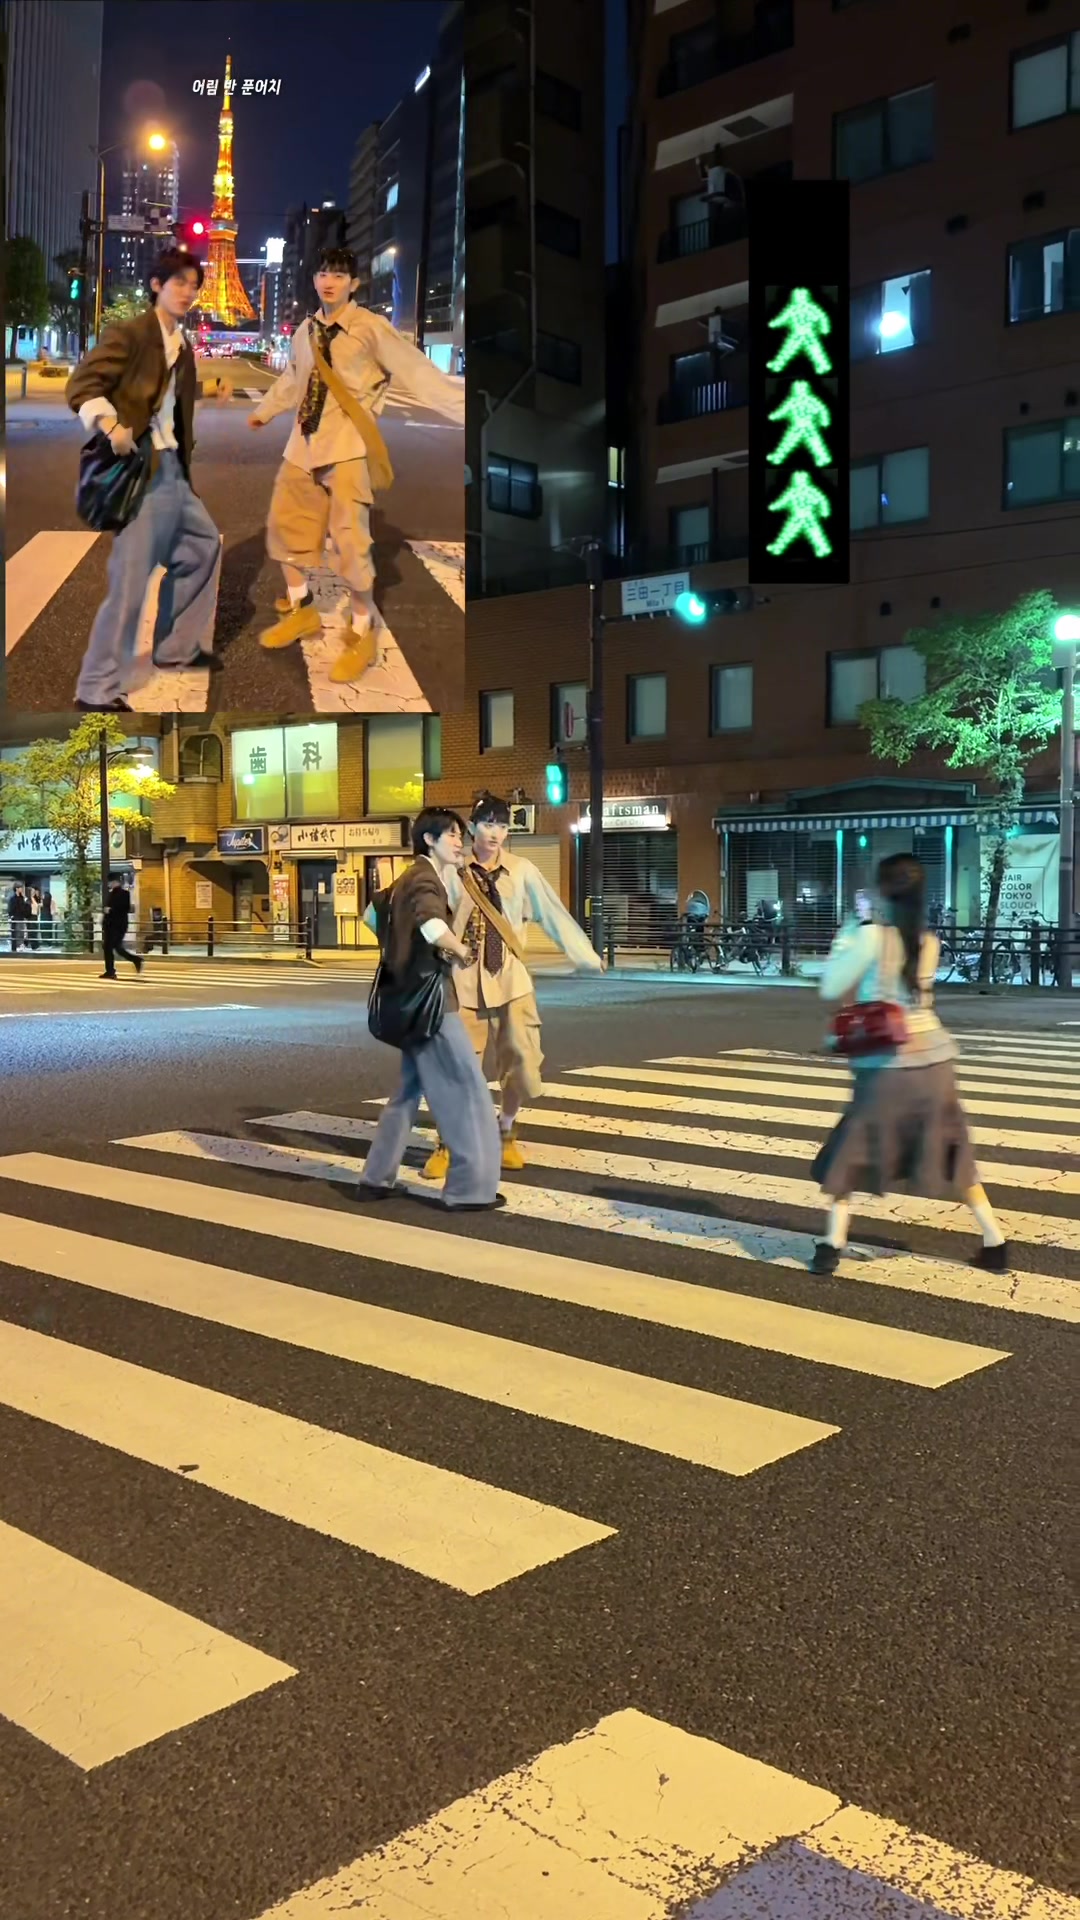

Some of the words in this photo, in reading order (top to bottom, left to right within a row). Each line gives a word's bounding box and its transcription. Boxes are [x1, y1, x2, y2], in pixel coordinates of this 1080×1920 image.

[627, 581, 684, 601] 三田一丁目
[249, 741, 322, 774] 歯科
[586, 804, 659, 816] Caftsman
[1000, 883, 1032, 891] COLOR
[1000, 892, 1032, 900] TOKYO
[1000, 901, 1037, 910] SLOUCH
